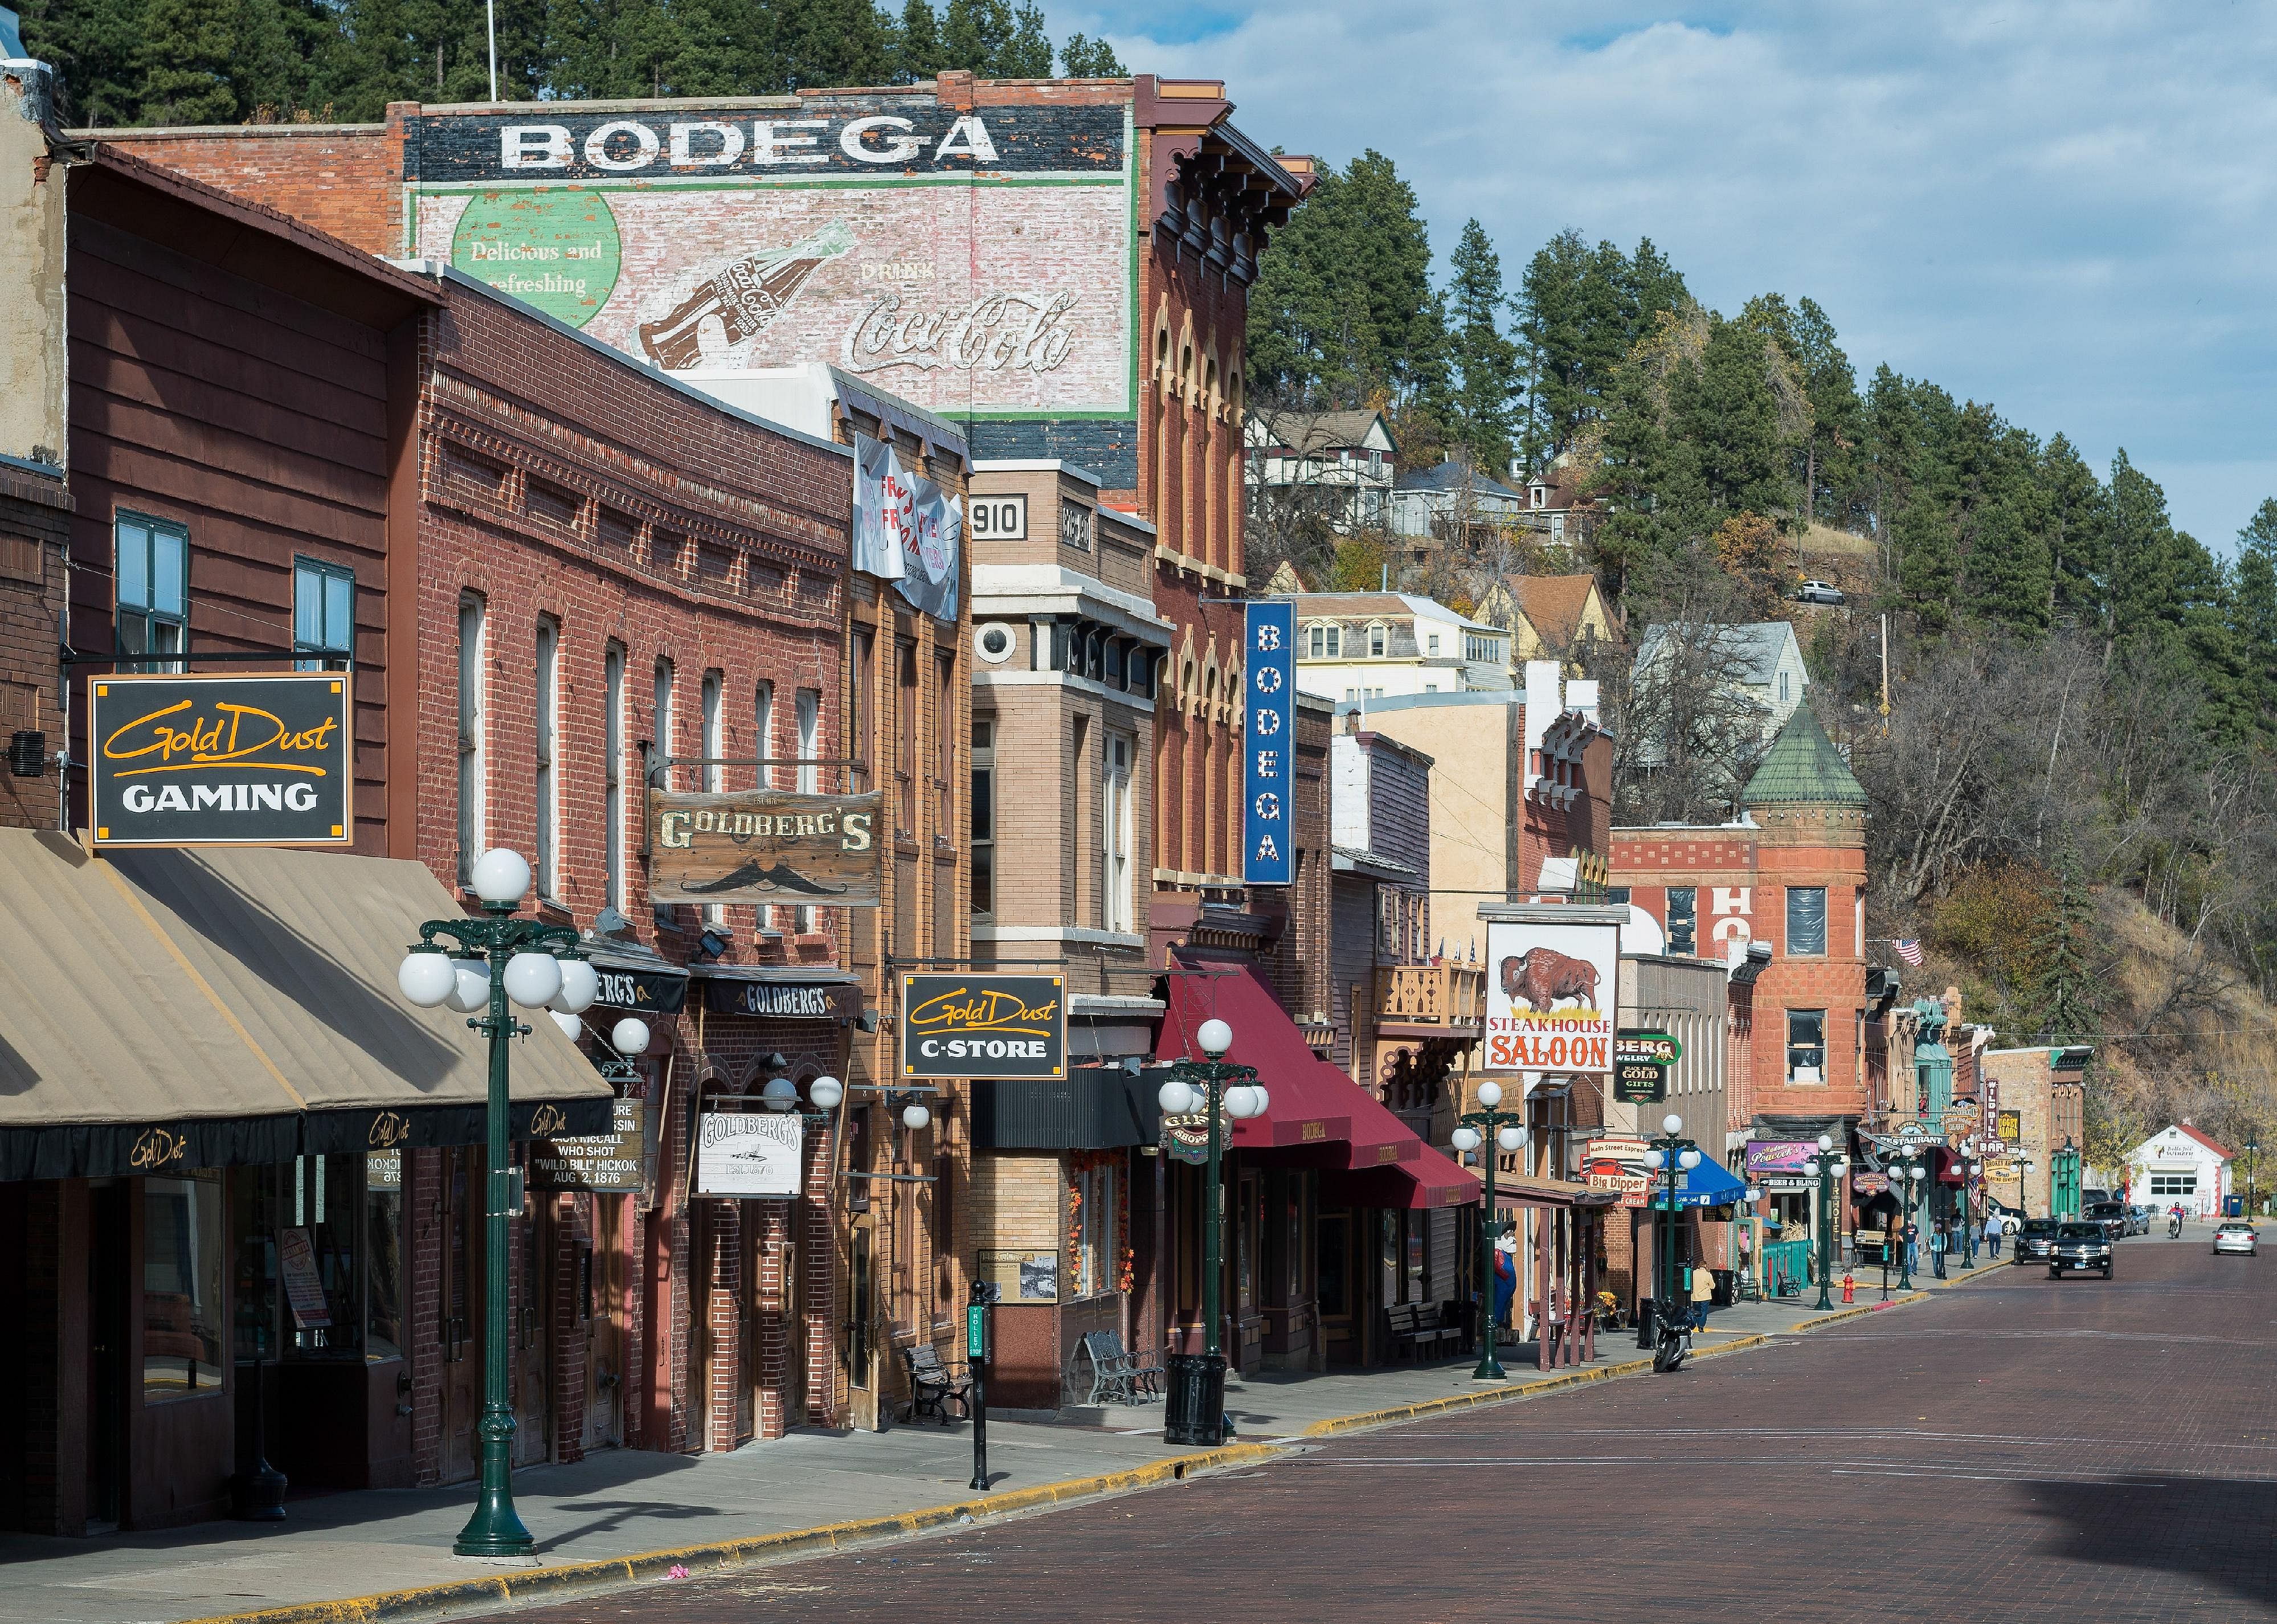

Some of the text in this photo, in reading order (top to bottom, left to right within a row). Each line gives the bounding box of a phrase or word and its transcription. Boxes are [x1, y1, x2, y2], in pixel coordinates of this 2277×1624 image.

[501, 116, 1000, 171] BODEGA
[471, 240, 602, 261] Delicious and
[860, 262, 936, 280] DRINK
[973, 504, 1017, 533] 910
[104, 699, 338, 762] Gold Dust
[1256, 624, 1282, 861] BODEGA
[122, 783, 319, 813] GAMING
[661, 807, 872, 850] GOLDBERG'S
[595, 971, 636, 1005] ERG'S
[910, 988, 1058, 1026] Gold Dust
[1489, 1017, 1611, 1033] STEAKHOUSE
[921, 1040, 1048, 1058] C-STORE
[1490, 1035, 1609, 1067] SALOON
[1622, 1070, 1658, 1079] GOLD
[1998, 1118, 2018, 1129] UGGET
[1998, 1127, 2018, 1138] ALOON
[704, 1116, 798, 1151] GOLDBERGS
[558, 1146, 615, 1156] WHO SHOT
[1749, 1144, 1798, 1165] Peacock's
[1761, 1144, 1789, 1155] Madame
[1980, 1143, 2005, 1152] BAR
[535, 1159, 637, 1171] "WILD BILL" HICKOK
[553, 1172, 621, 1185] AUG 2, 1876
[1592, 1176, 1645, 1191] Big Dipper
